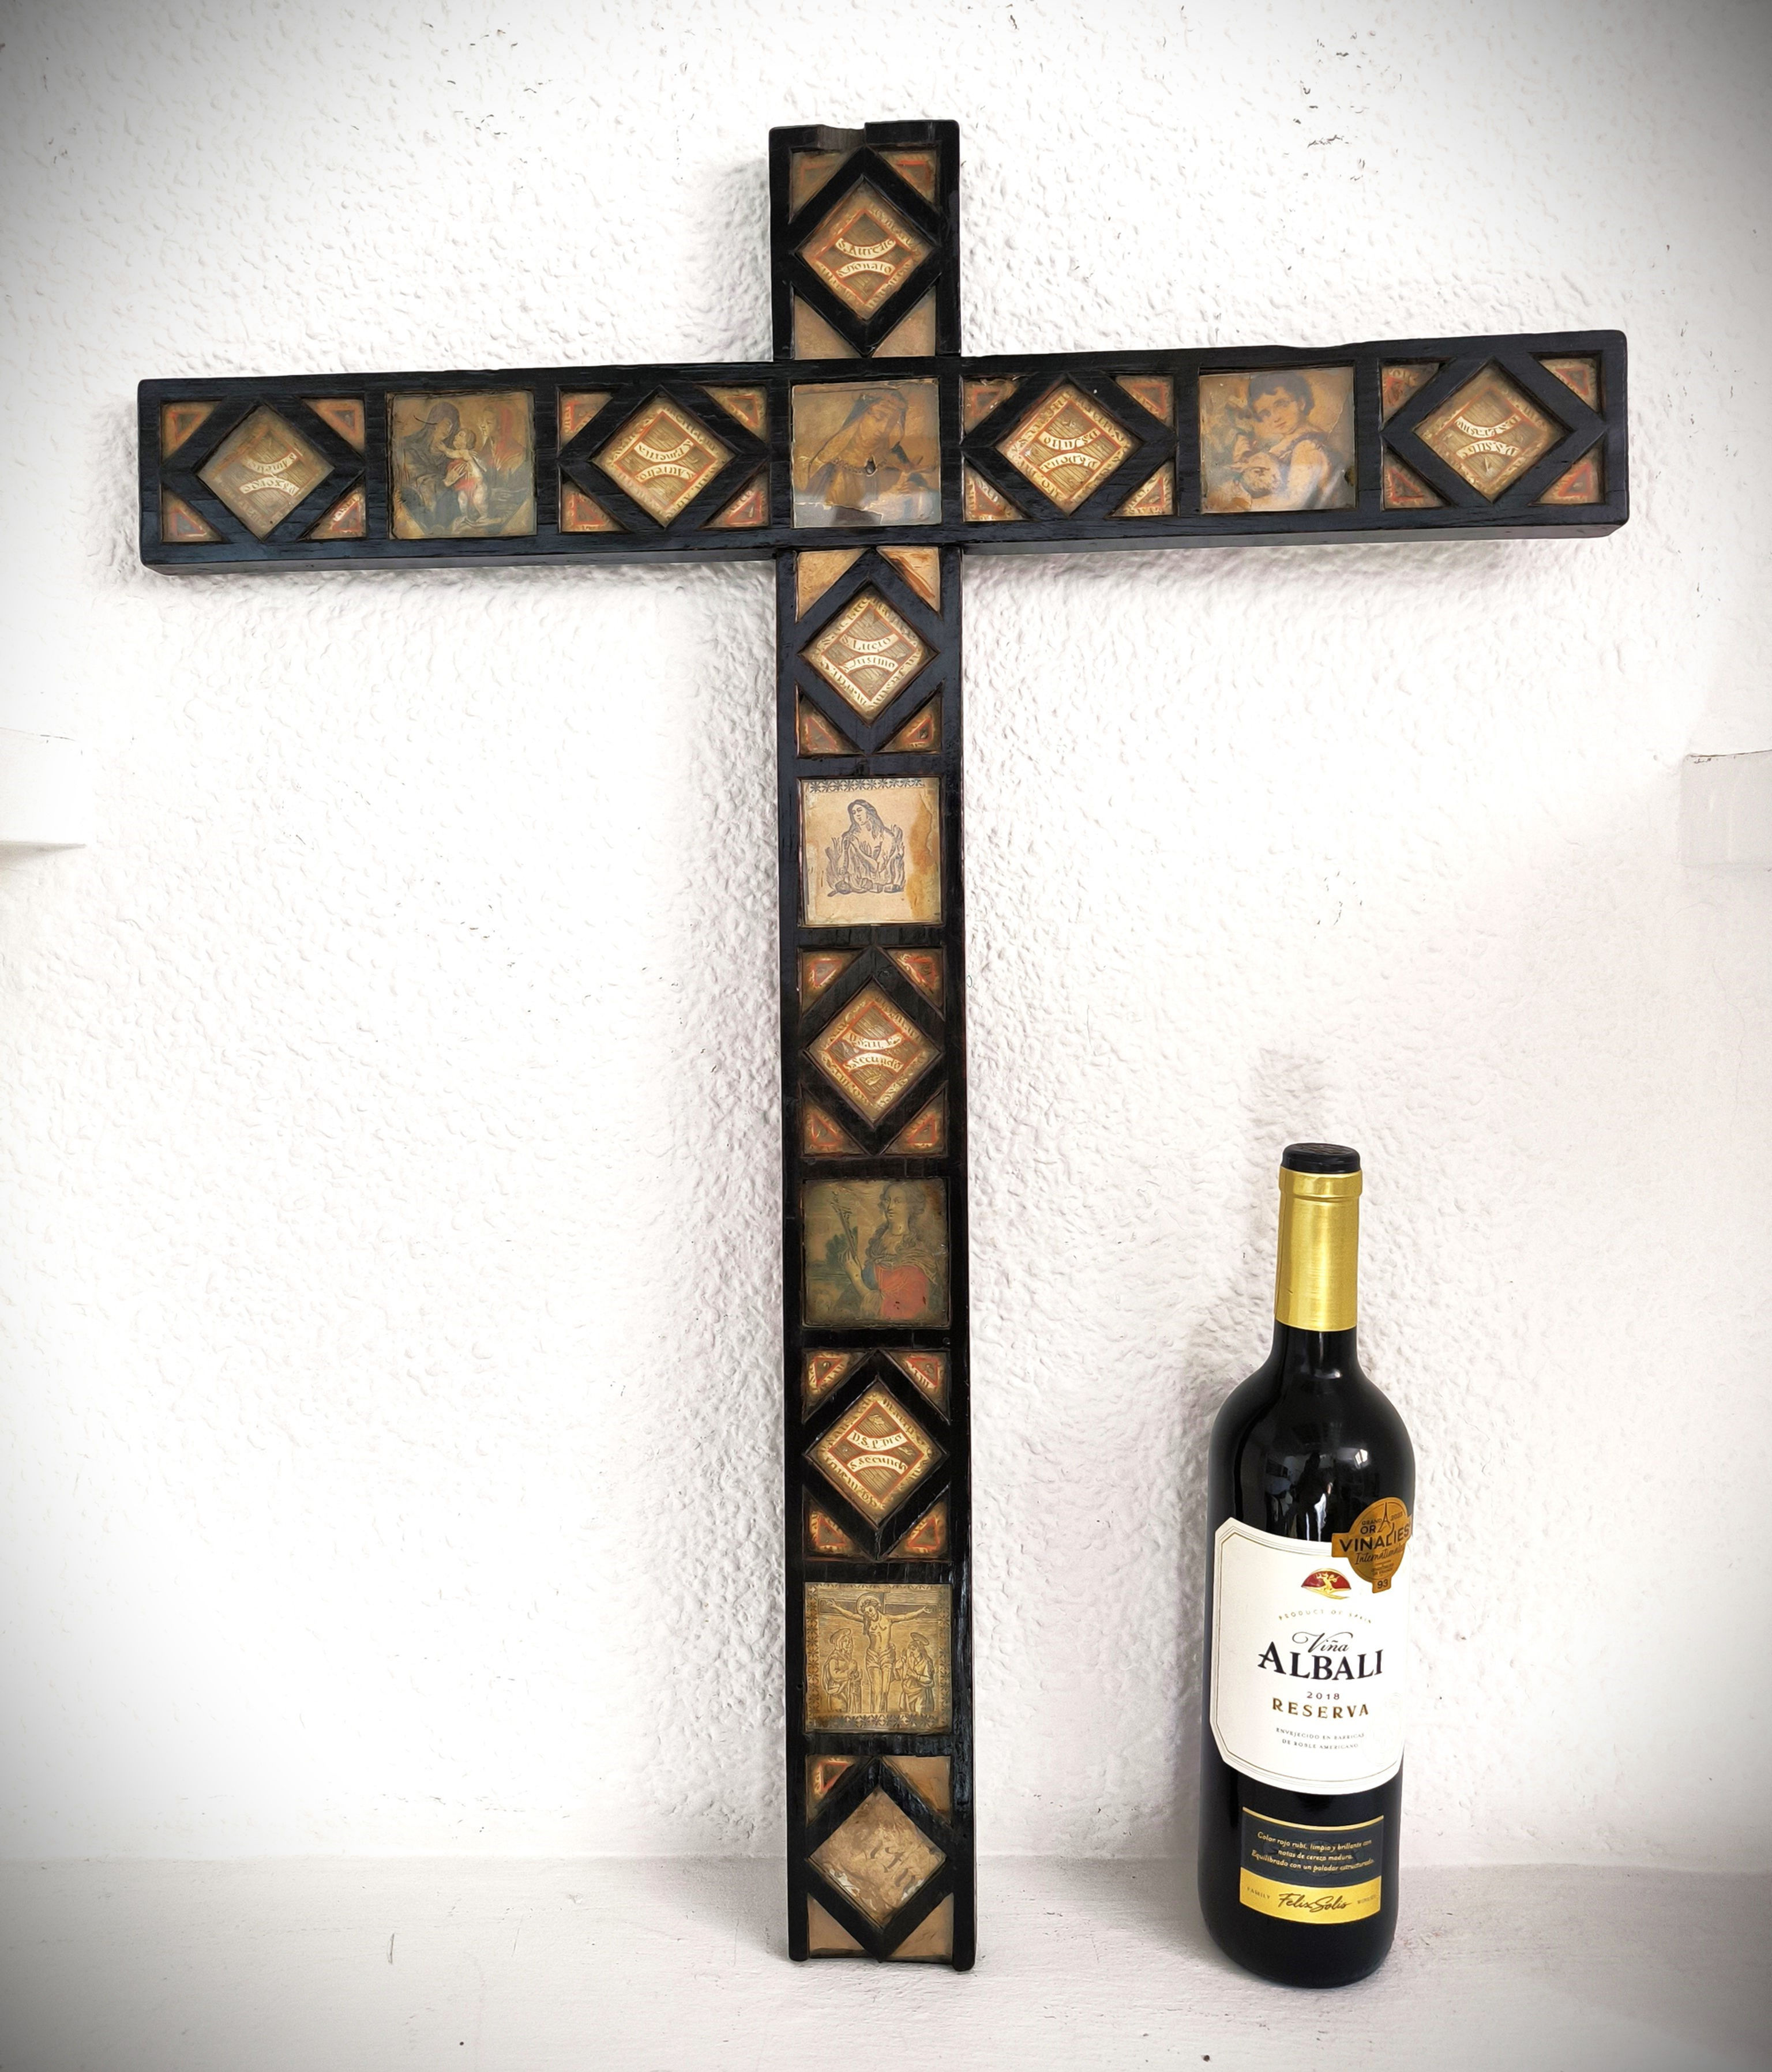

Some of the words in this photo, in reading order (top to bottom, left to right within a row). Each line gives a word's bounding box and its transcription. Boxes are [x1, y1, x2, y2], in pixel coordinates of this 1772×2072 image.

[1339, 1522, 1410, 1552] VINALIES
[1360, 1525, 1376, 1535] OR
[1377, 1578, 1388, 1589] 93
[1279, 1609, 1324, 1621] PRODUCT
[1292, 1631, 1353, 1653] Viña
[1257, 1641, 1384, 1680] ALBALI
[1307, 1691, 1340, 1700] 2018
[1272, 1697, 1369, 1718] RESERVA
[1276, 1727, 1320, 1740] ENVEJECIDO
[1294, 1741, 1317, 1749] ROBLE
[1257, 1831, 1276, 1842] Color
[1277, 1838, 1291, 1848] rojo
[1310, 1843, 1331, 1852] limpio
[1251, 1849, 1289, 1867] Equilibrado
[1312, 1864, 1339, 1873] paladar
[1278, 1849, 1296, 1858] notas
[1278, 1893, 1313, 1908] Felix
[1309, 1896, 1351, 1913] Solis
